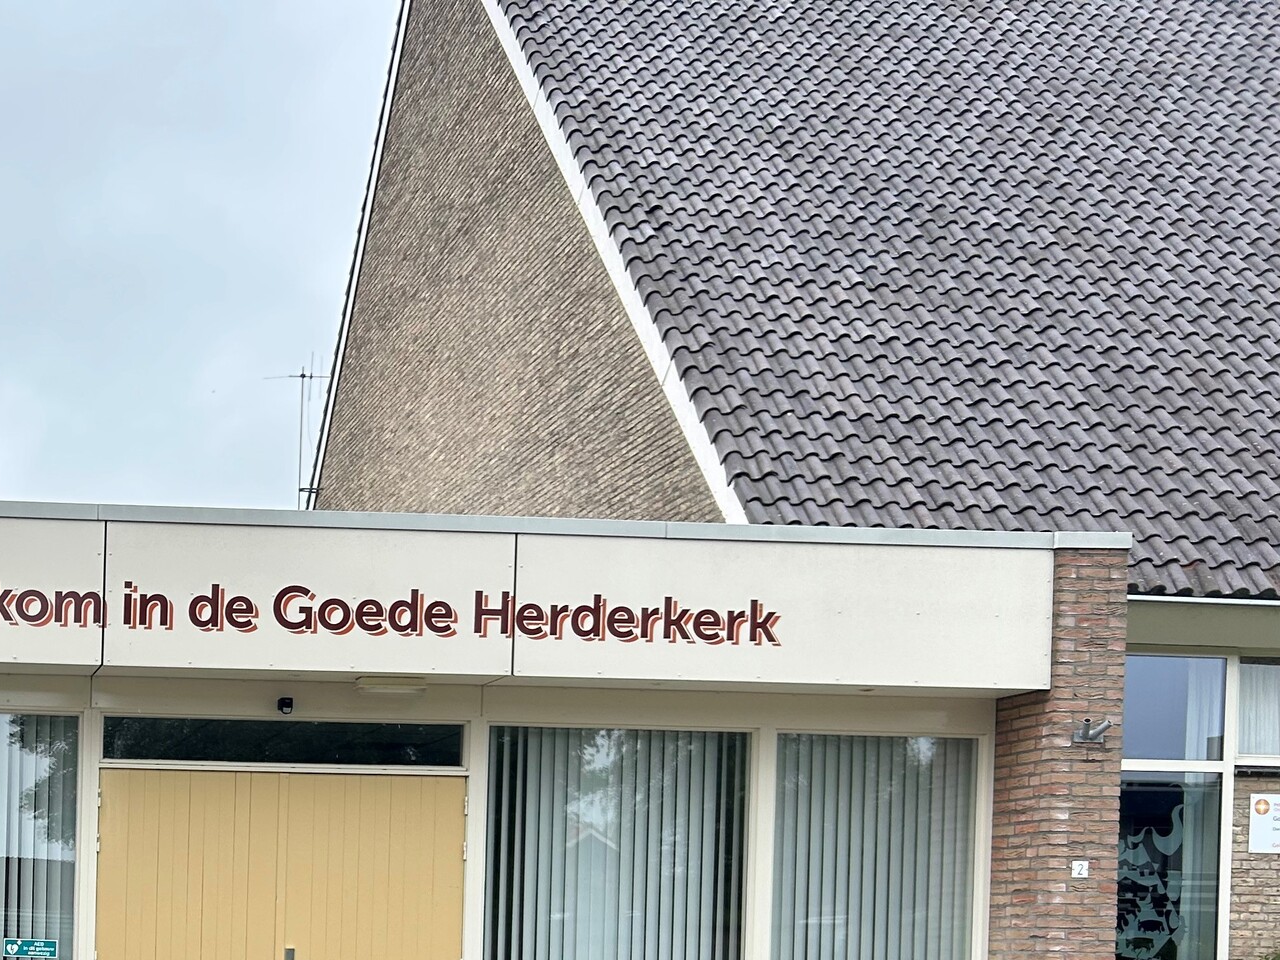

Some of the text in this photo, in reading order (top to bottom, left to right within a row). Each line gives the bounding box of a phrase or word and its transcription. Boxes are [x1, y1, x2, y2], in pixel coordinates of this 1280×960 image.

[123, 581, 174, 630] in
[188, 583, 260, 634] de
[273, 584, 458, 638] Goede
[473, 589, 783, 647] Herderkerk
[1077, 863, 1084, 875] 2
